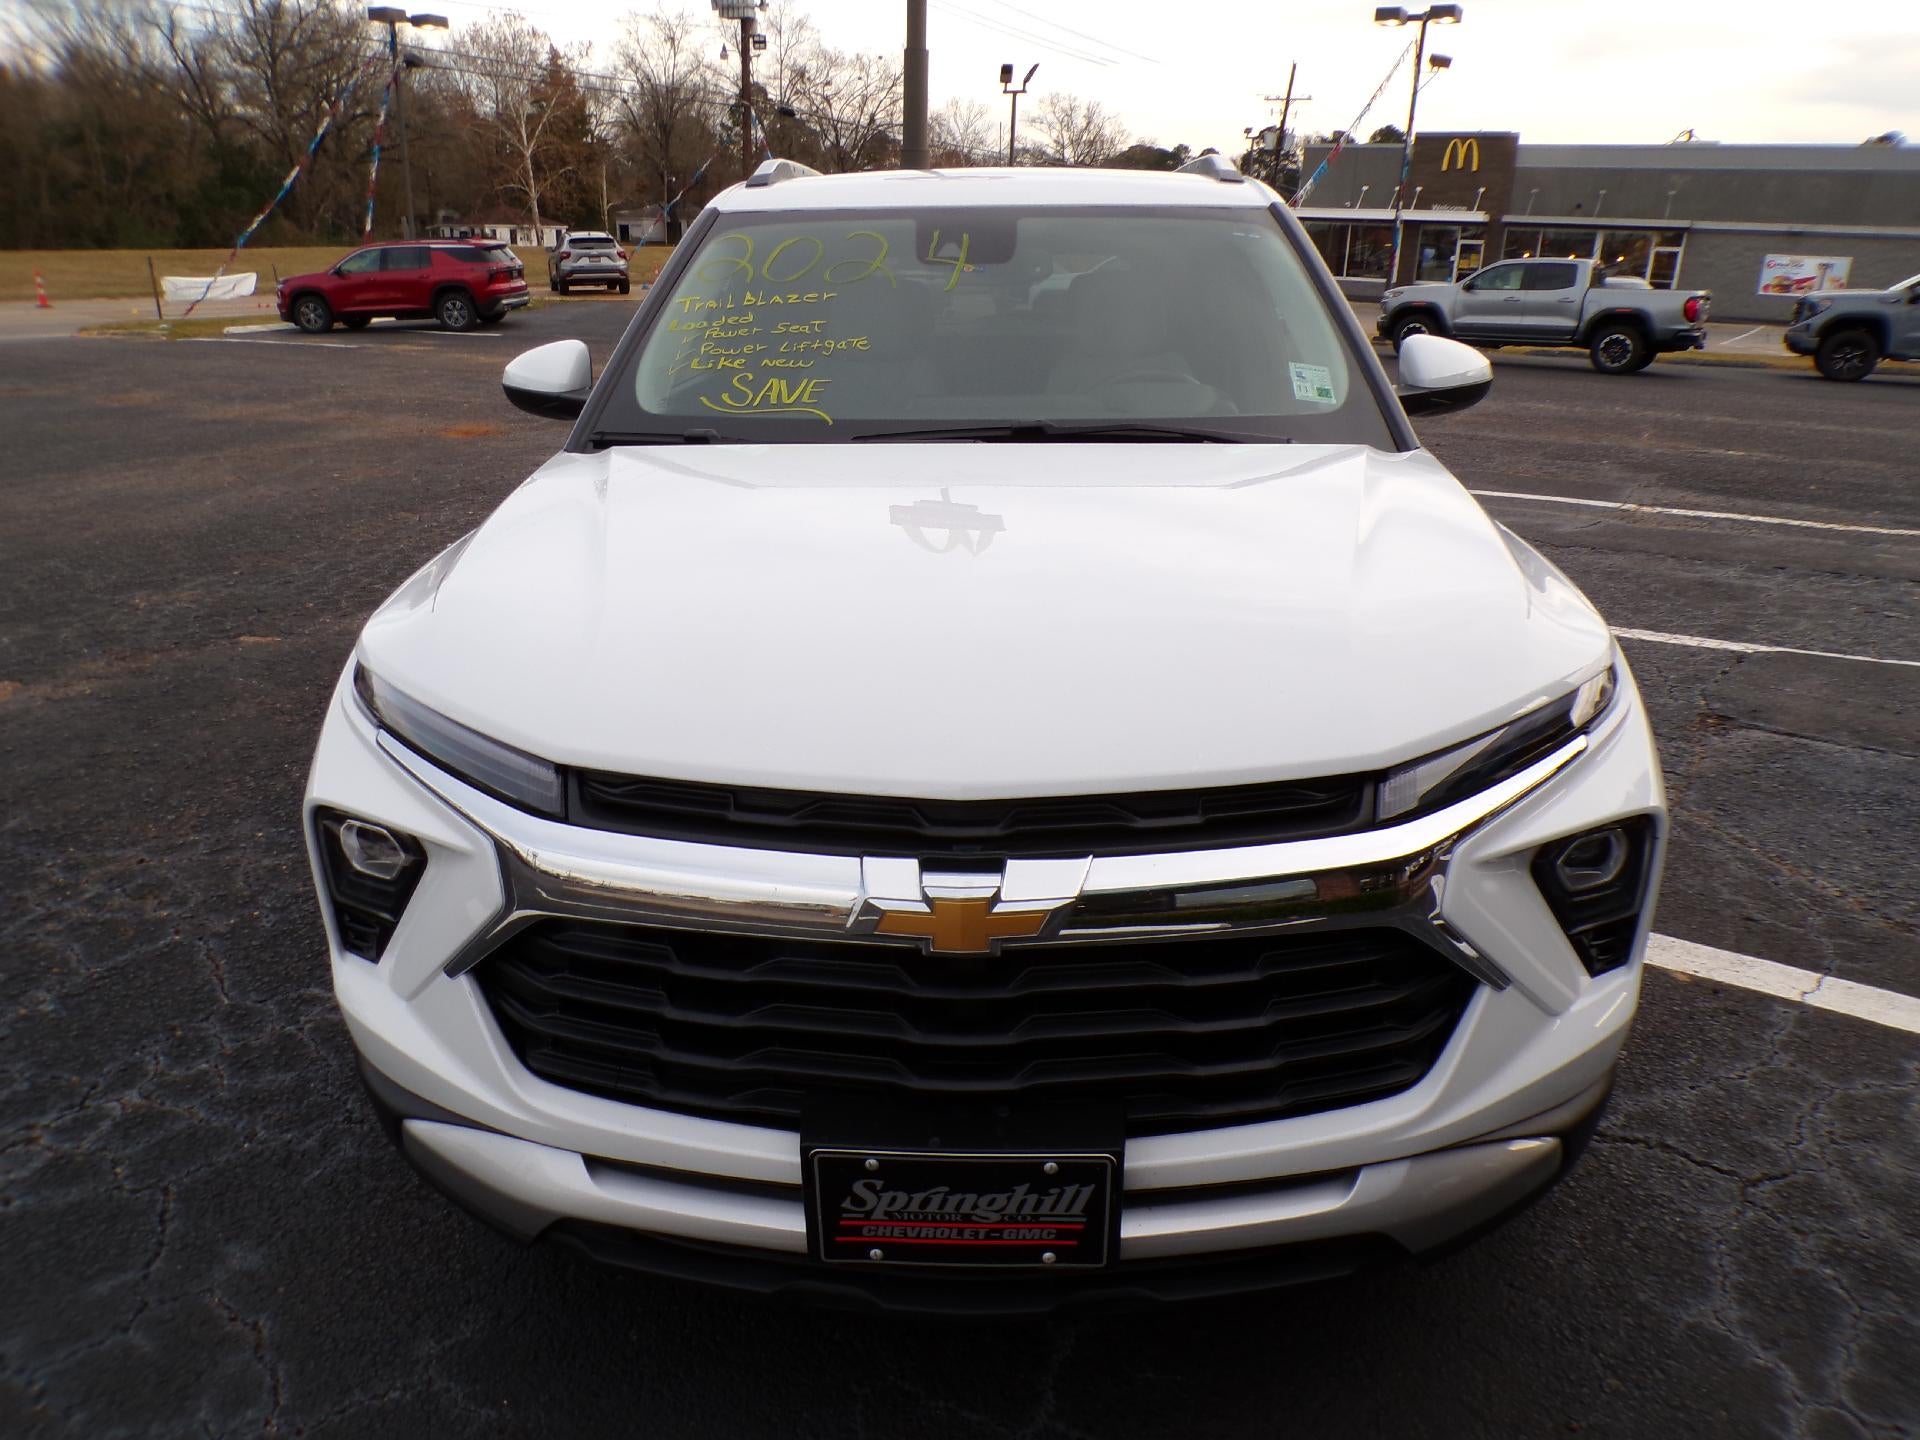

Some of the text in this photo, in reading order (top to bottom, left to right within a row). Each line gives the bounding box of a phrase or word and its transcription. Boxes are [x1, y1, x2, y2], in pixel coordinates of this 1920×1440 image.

[697, 231, 973, 292] 2024
[704, 327, 763, 339] Power
[701, 342, 768, 355] Power
[691, 356, 746, 370] Like
[721, 372, 832, 407] SAVE
[840, 1178, 1096, 1224] Springhill
[893, 1211, 1037, 1222] MOTOR CO.
